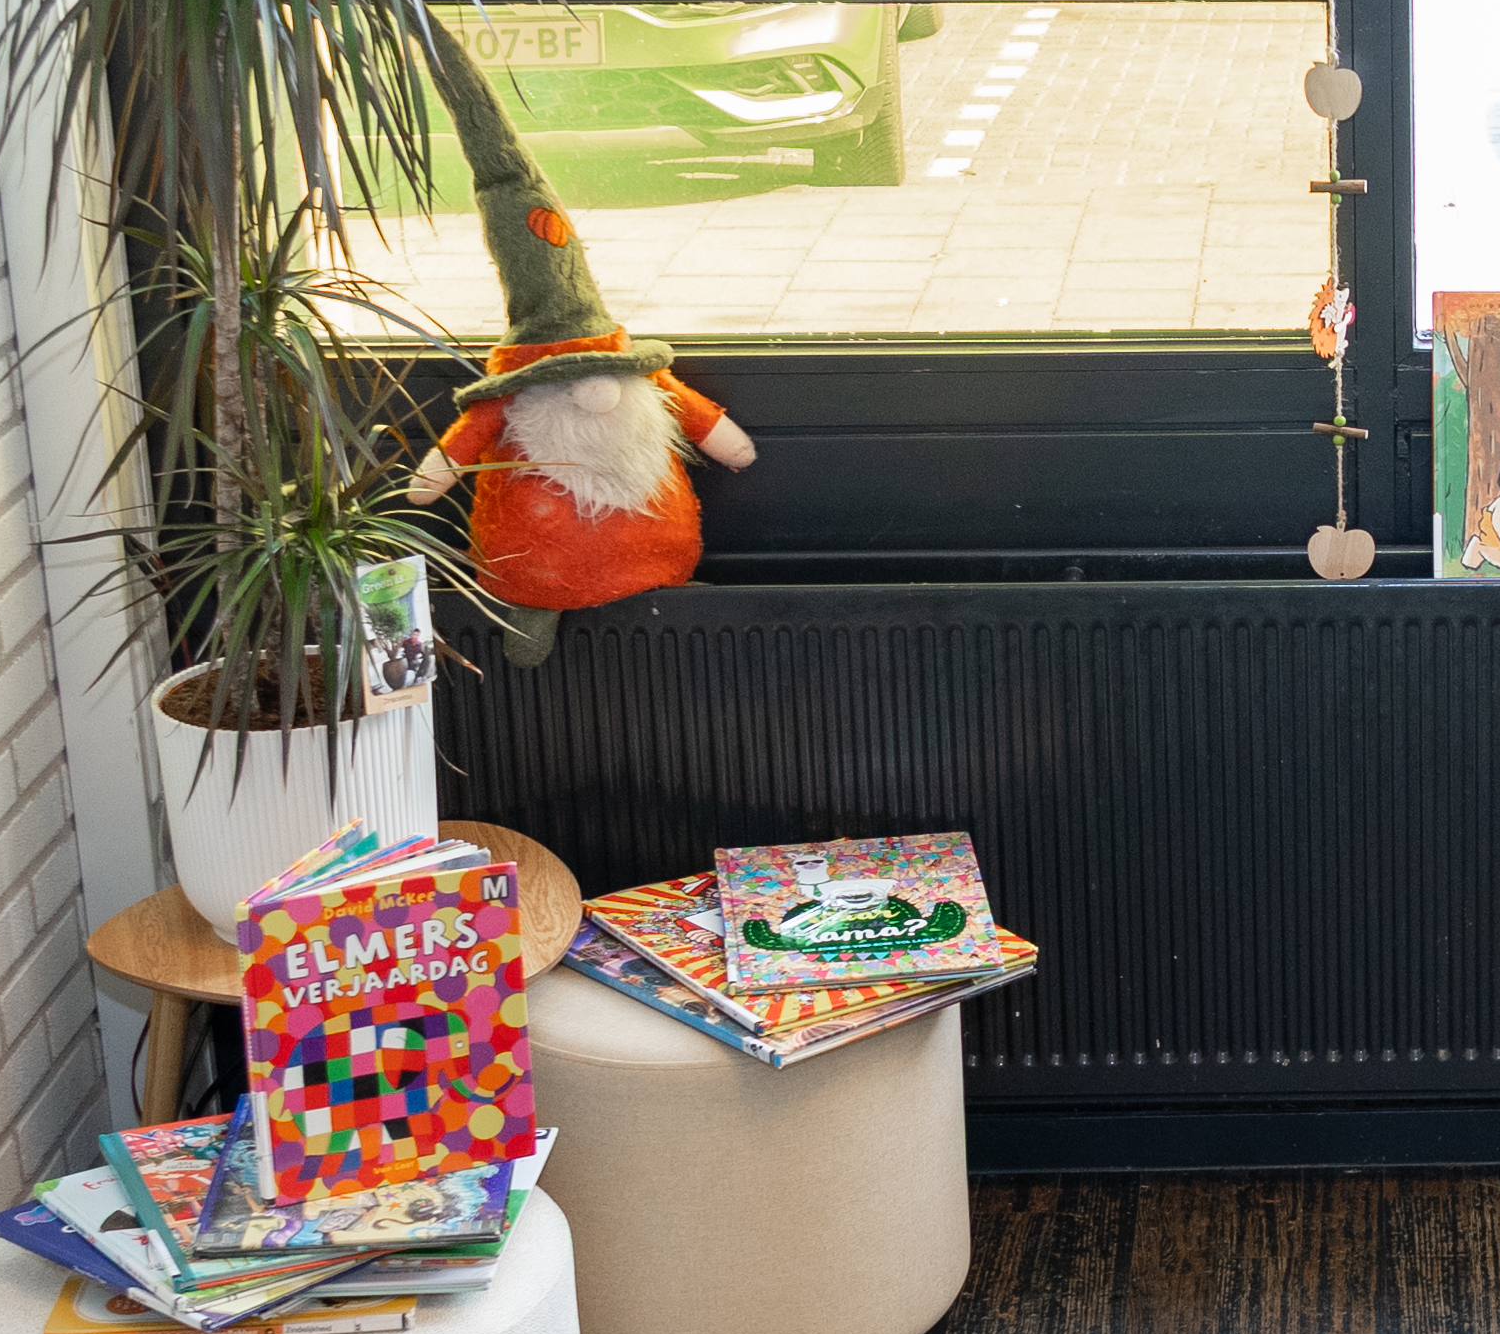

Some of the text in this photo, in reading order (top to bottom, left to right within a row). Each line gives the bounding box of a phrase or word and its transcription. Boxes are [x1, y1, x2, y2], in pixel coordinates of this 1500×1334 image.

[324, 890, 436, 920] David McKee
[483, 876, 508, 899] M
[285, 913, 478, 980] ELMERS
[282, 951, 488, 1008] VERJAARDAG
